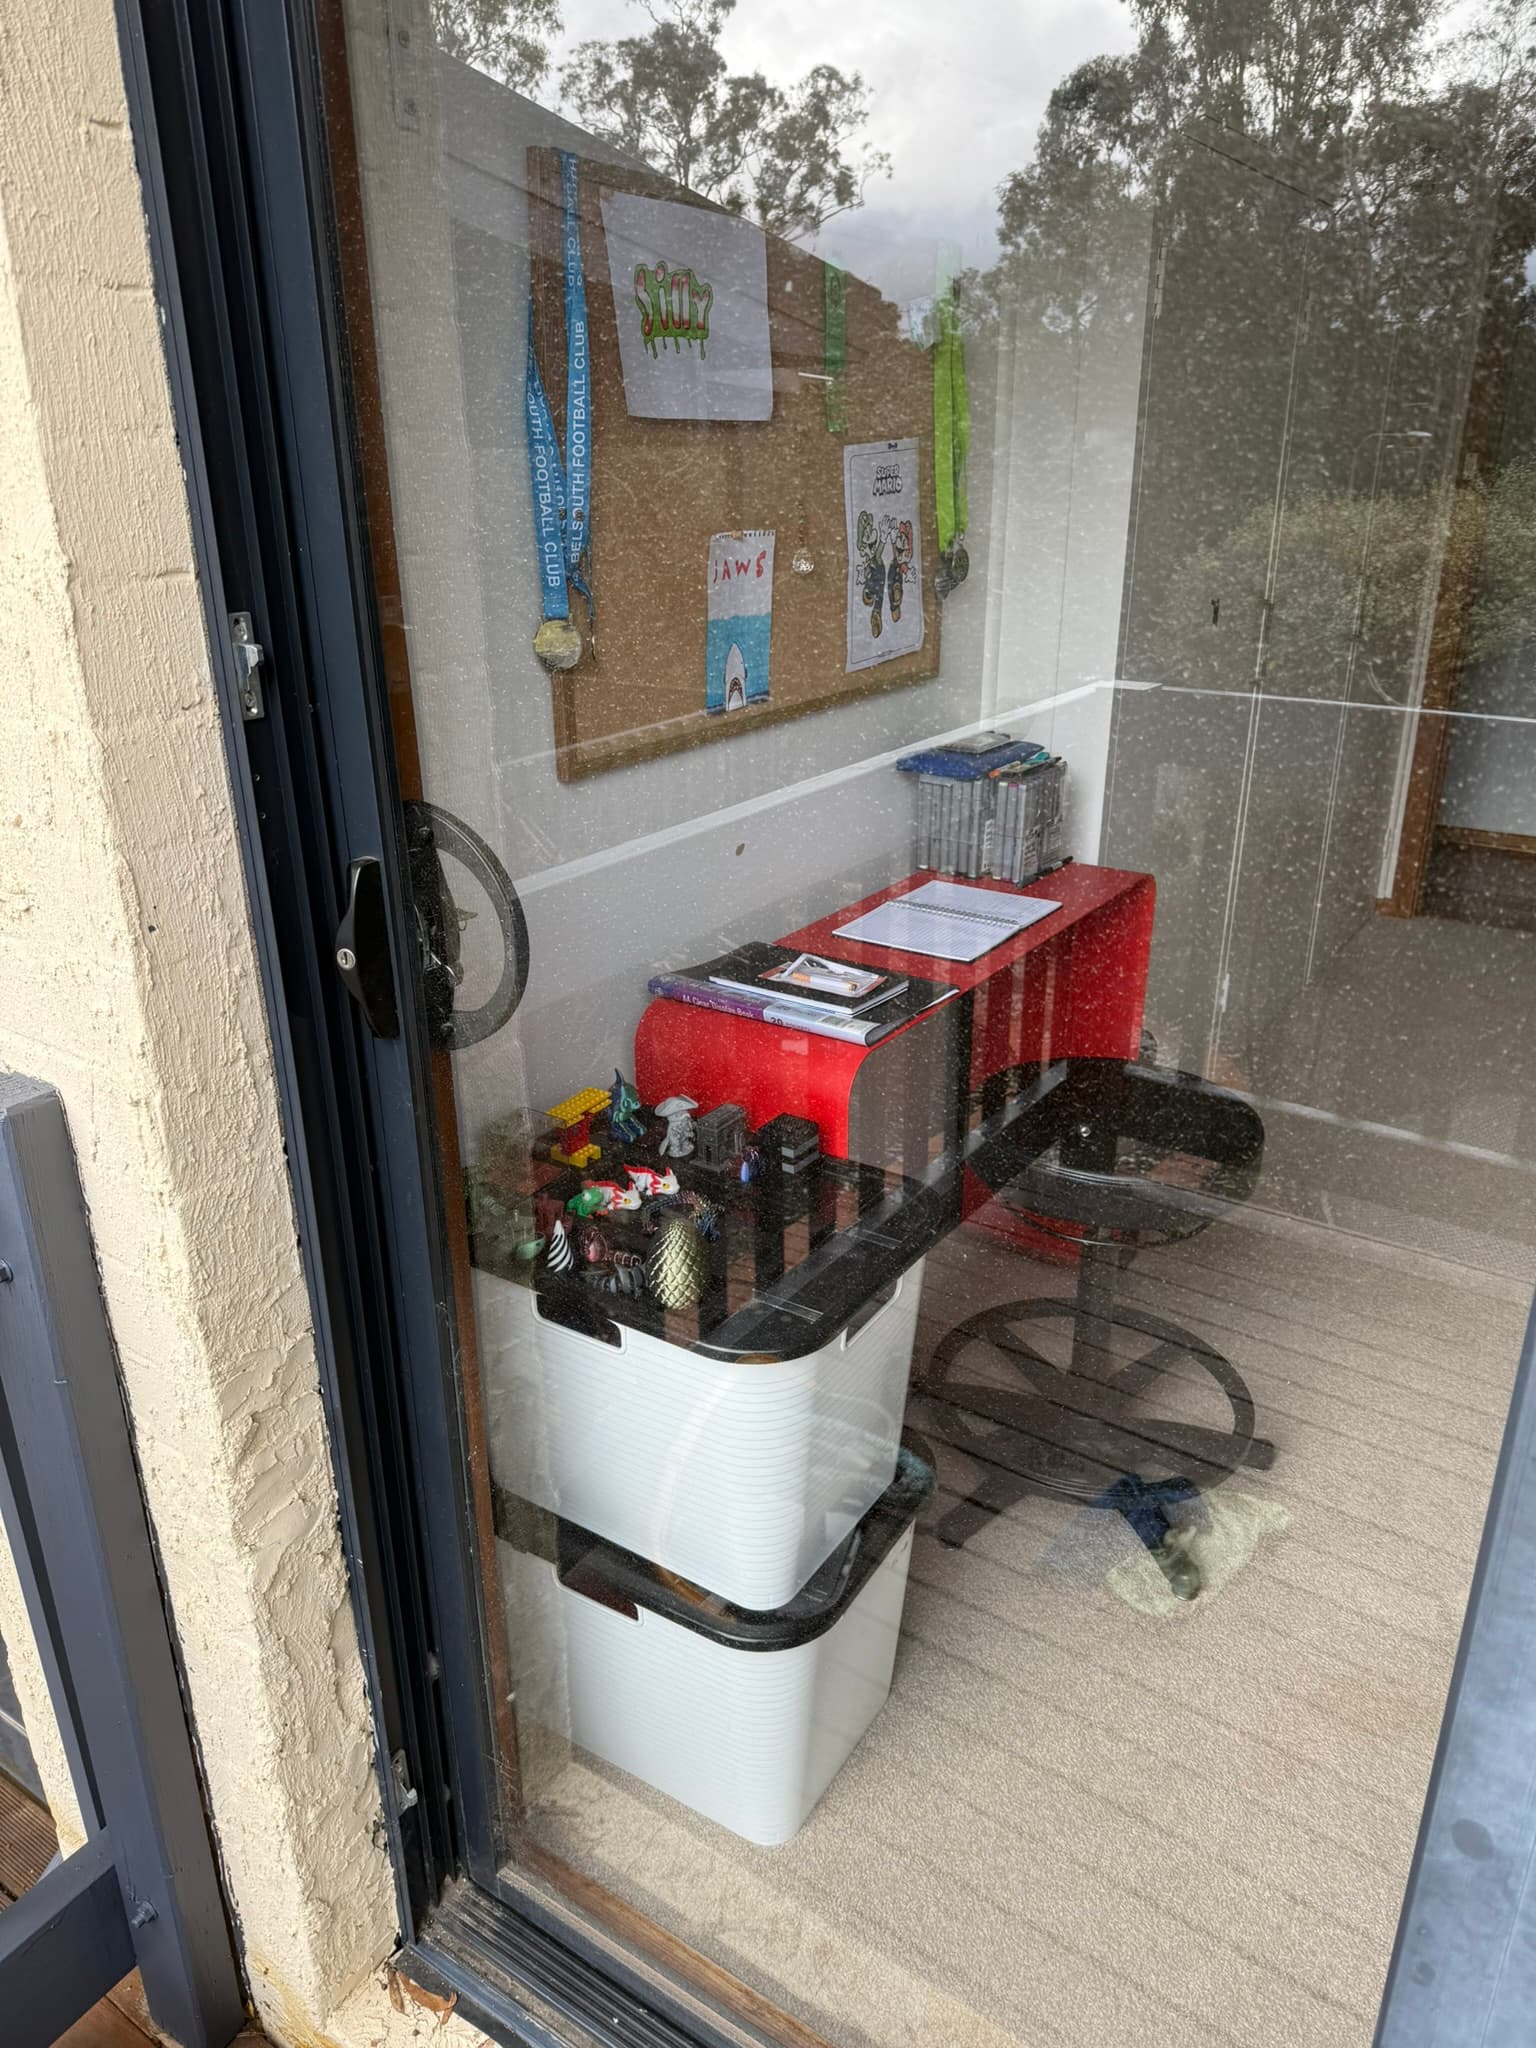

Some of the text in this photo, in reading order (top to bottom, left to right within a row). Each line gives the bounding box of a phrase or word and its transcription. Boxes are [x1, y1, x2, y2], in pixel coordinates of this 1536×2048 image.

[574, 320, 586, 369] CLUB
[572, 375, 586, 468] FOOTBALL
[534, 445, 555, 538] FOOTBALL
[872, 477, 903, 496] MARIO
[875, 463, 900, 478] SUPER
[544, 542, 561, 588] CLUB
